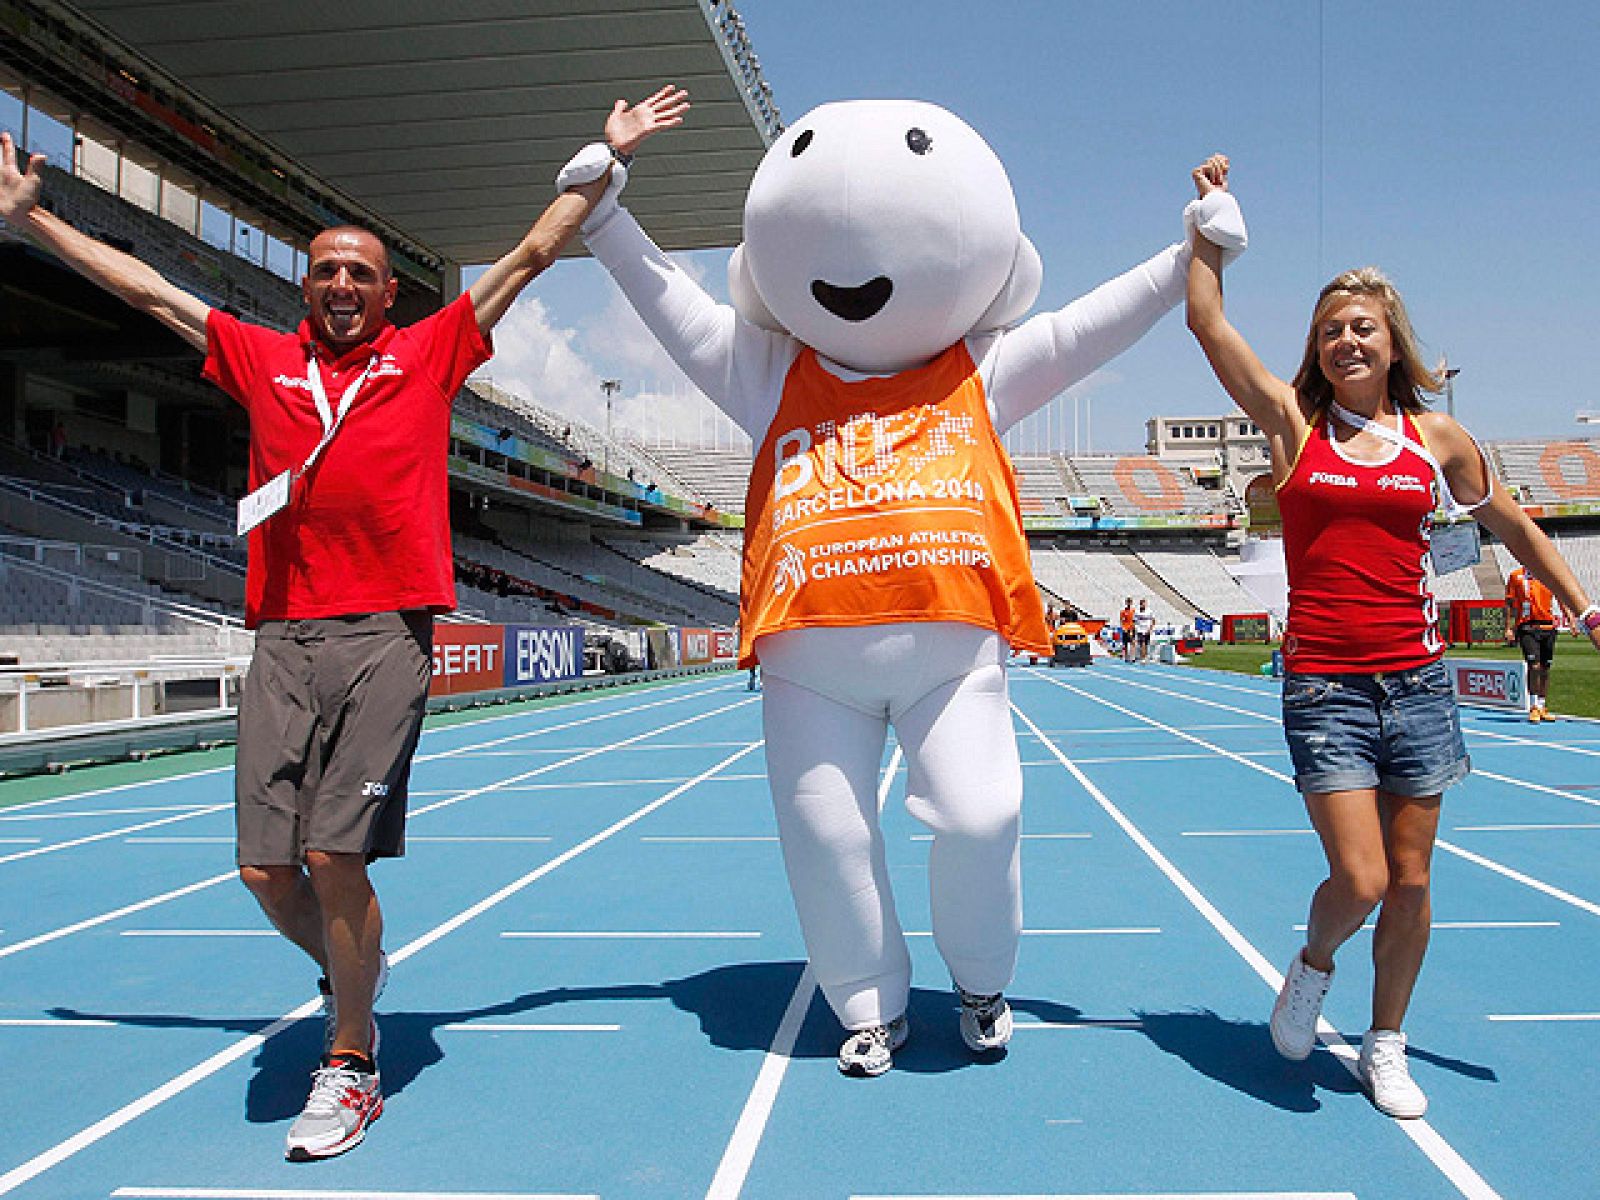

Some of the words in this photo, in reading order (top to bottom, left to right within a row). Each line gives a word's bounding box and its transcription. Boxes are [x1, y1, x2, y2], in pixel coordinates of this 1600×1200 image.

[773, 479, 926, 531] BARCELONA
[933, 478, 984, 501] 2010
[809, 534, 904, 559] EUROPEAN
[811, 546, 991, 580] CHAMPIONSHIPS
[516, 629, 576, 681] EPSON
